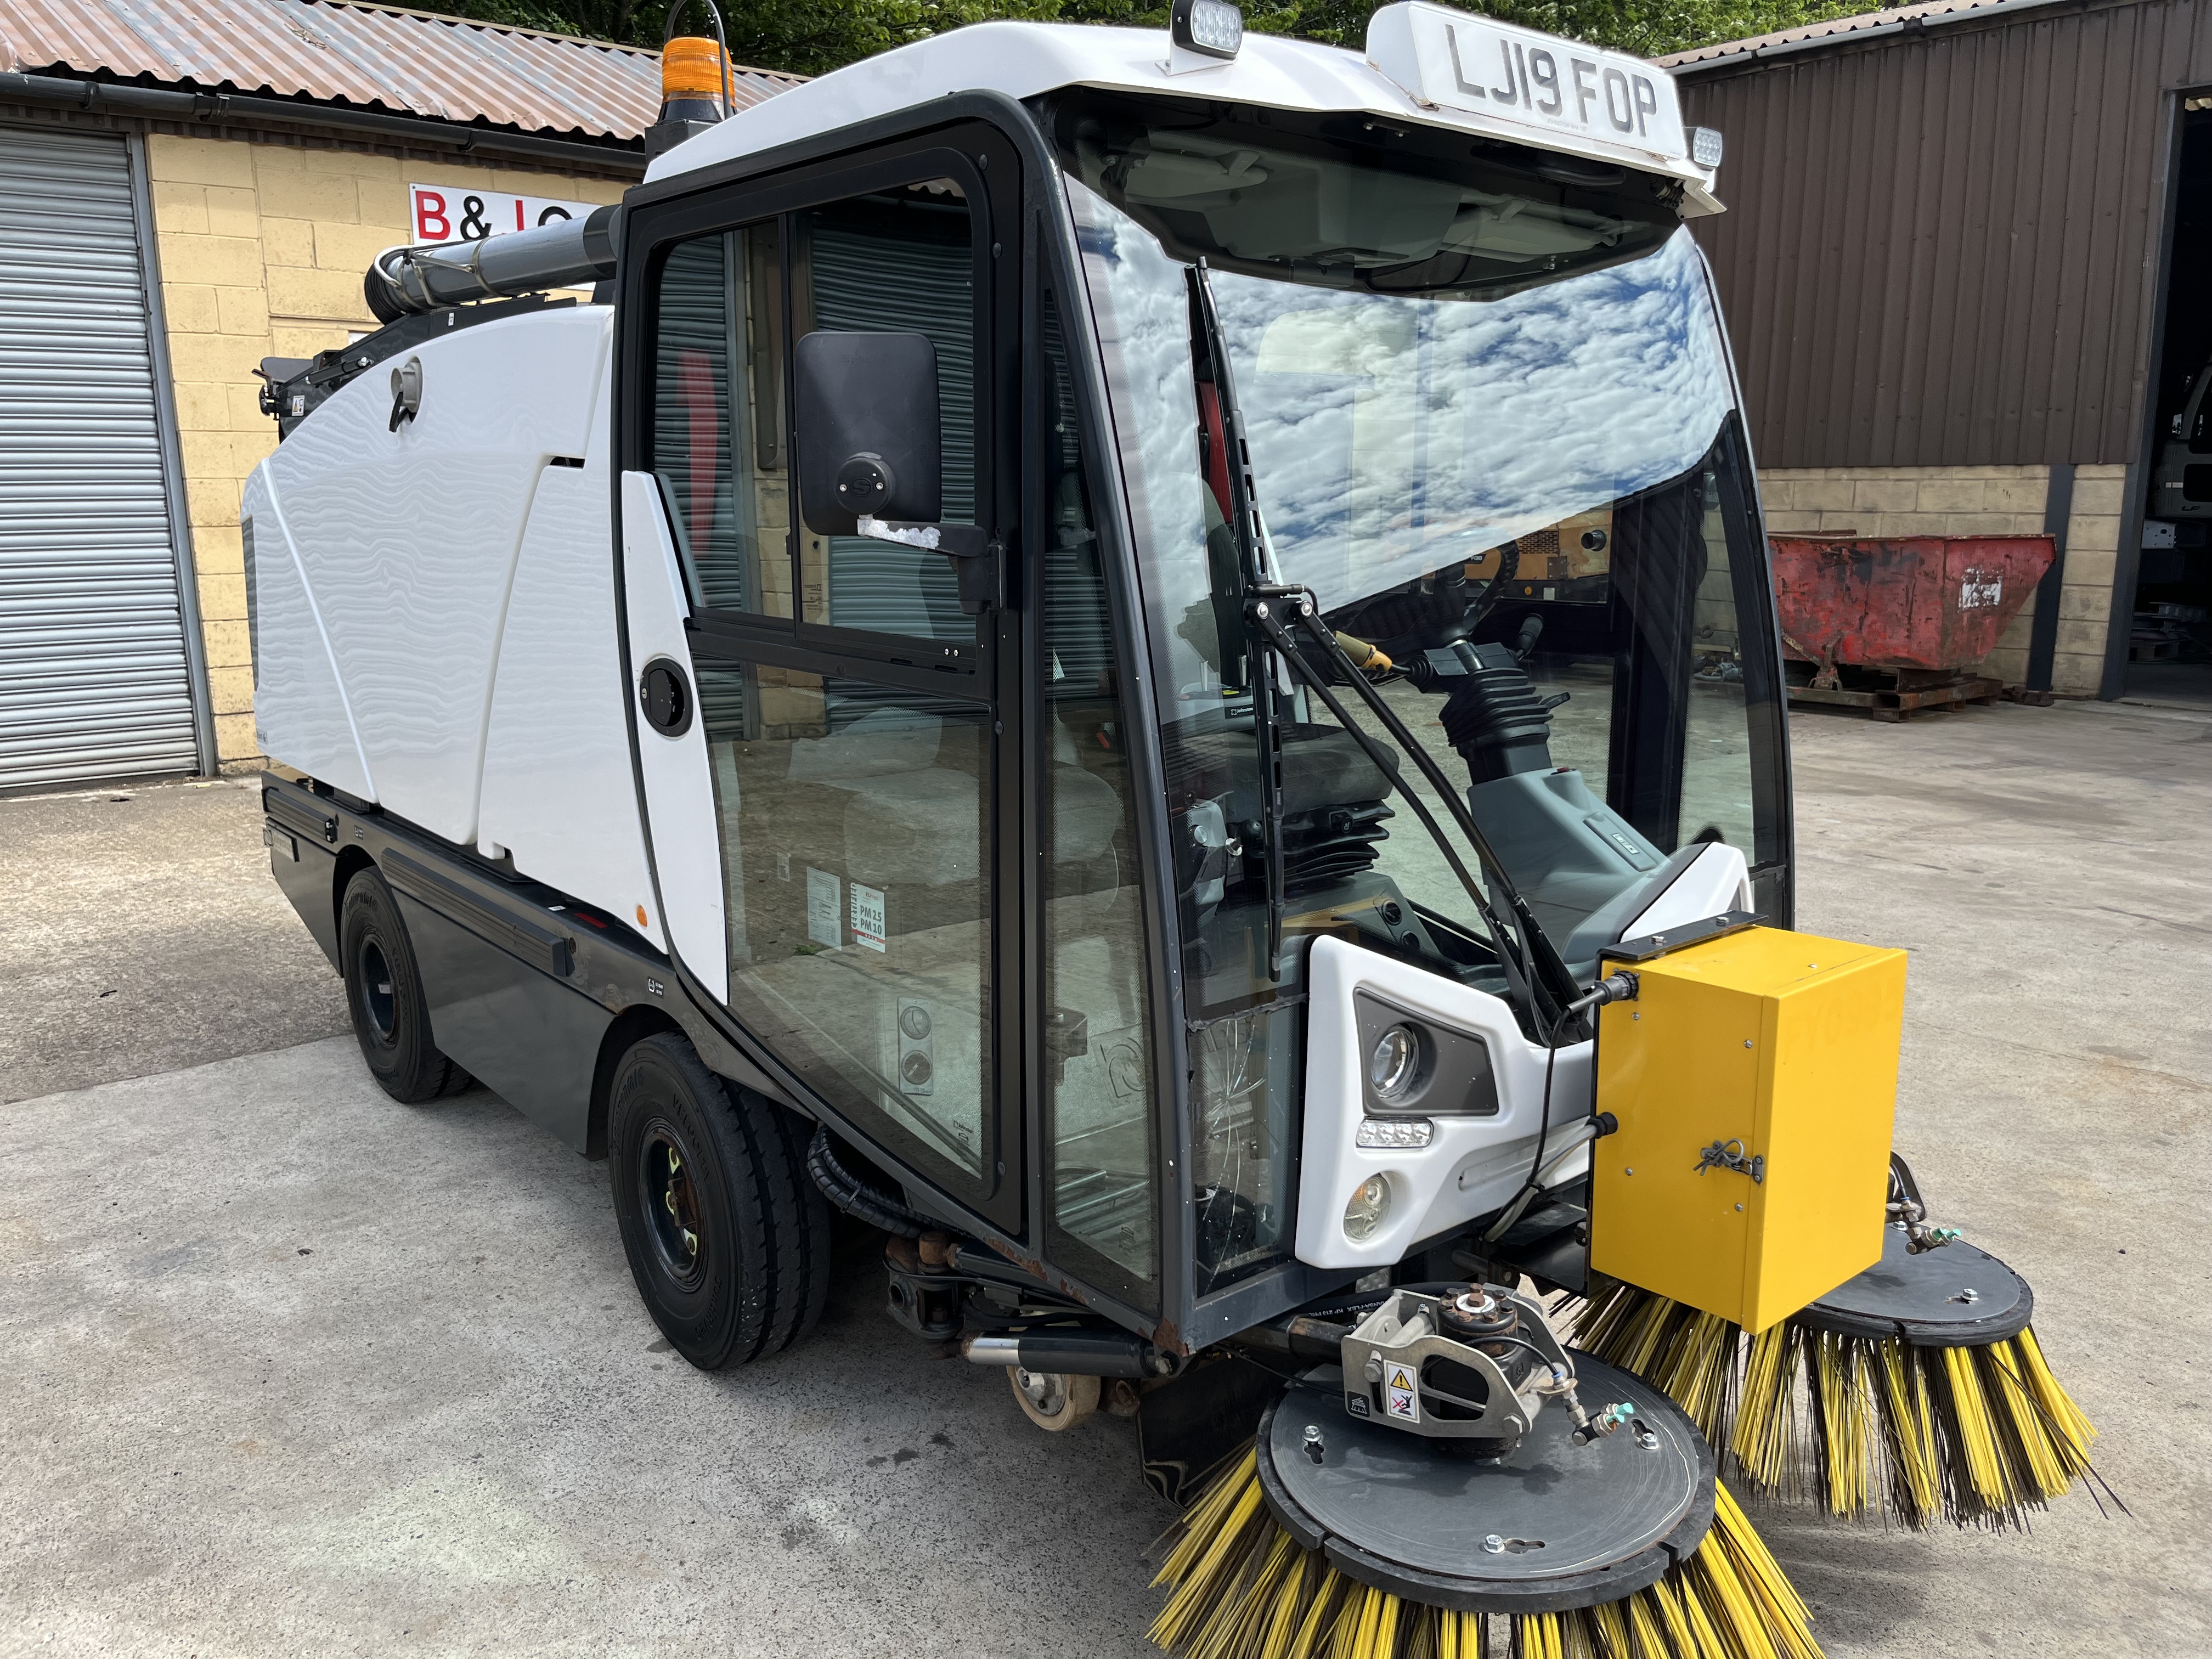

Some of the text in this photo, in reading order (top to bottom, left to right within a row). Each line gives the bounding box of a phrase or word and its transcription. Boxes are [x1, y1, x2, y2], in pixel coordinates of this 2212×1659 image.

[1445, 24, 1657, 138] LJ19 FOP
[415, 190, 450, 240] B
[460, 195, 492, 240] &
[860, 905, 871, 918] PM
[860, 918, 882, 935] PM 10
